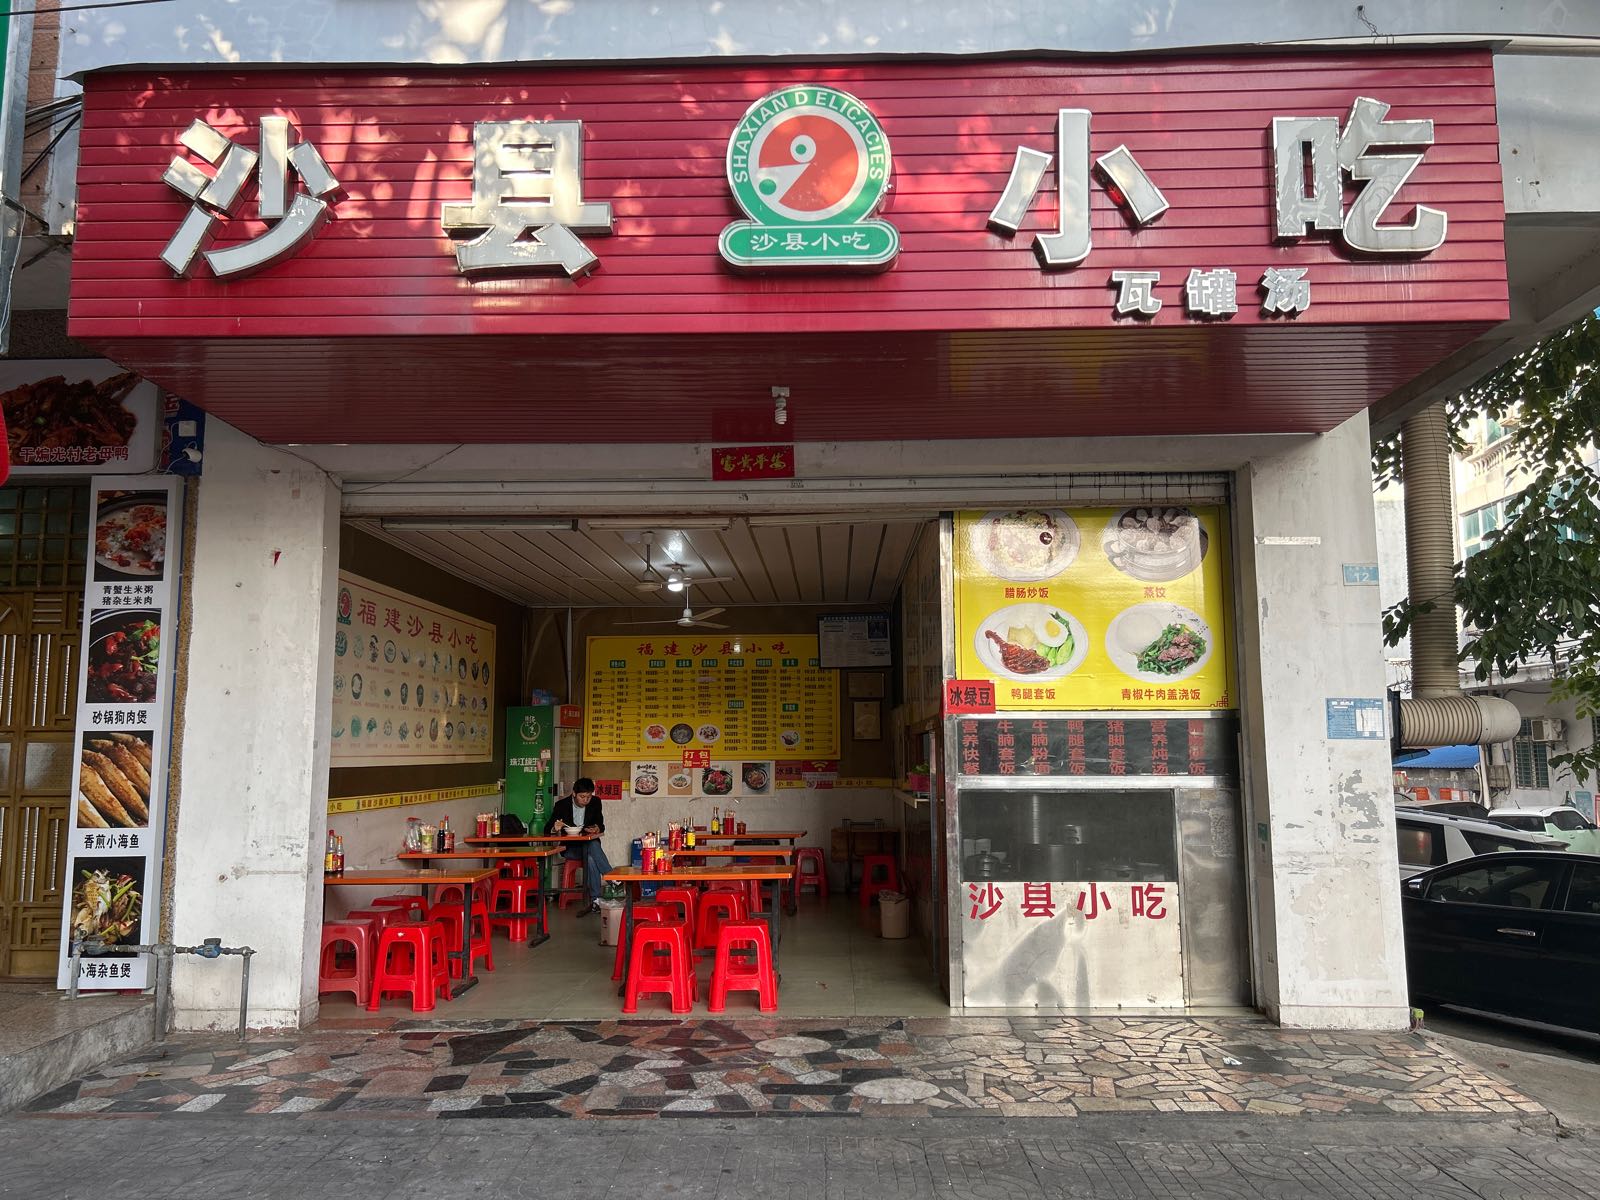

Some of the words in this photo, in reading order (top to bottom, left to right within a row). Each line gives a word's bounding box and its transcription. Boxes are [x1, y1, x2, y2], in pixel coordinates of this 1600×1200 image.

[734, 96, 789, 183] SHAXIAN
[795, 91, 884, 180] DELICACIES
[160, 115, 614, 281] 沙县
[989, 97, 1448, 268] 小吃
[750, 231, 870, 251] 沙县小吃
[1111, 267, 1311, 318] 瓦罐汤
[1354, 572, 1369, 582] 12
[103, 585, 154, 595] 青蟹生米粥
[1004, 587, 1049, 599] 腊肠炒饭
[1143, 586, 1167, 599] 蒸饺
[102, 596, 153, 606] 猪杂生米肉
[357, 598, 478, 655] 福建沙县小吃
[637, 641, 790, 657] 福建沙县小吃
[949, 687, 992, 707] 冰绿豆
[1011, 688, 1056, 701] 鸭腿套饭
[1121, 688, 1201, 701] 青椒牛肉盖浇饭
[93, 710, 147, 724] 砂锅狗肉煲
[684, 751, 709, 759] 打包
[961, 719, 980, 775] 营养快餐
[997, 719, 1016, 775] 牛腩套饭
[1067, 719, 1086, 775] 鸭腿套饭
[1107, 719, 1127, 775] 猪脚套饭
[1150, 719, 1169, 775] 营养炖汤
[683, 759, 709, 768] 加一元
[595, 784, 620, 796] 冰绿豆
[84, 834, 139, 849] 香煎小海鱼
[968, 882, 1167, 920] 沙县小吃
